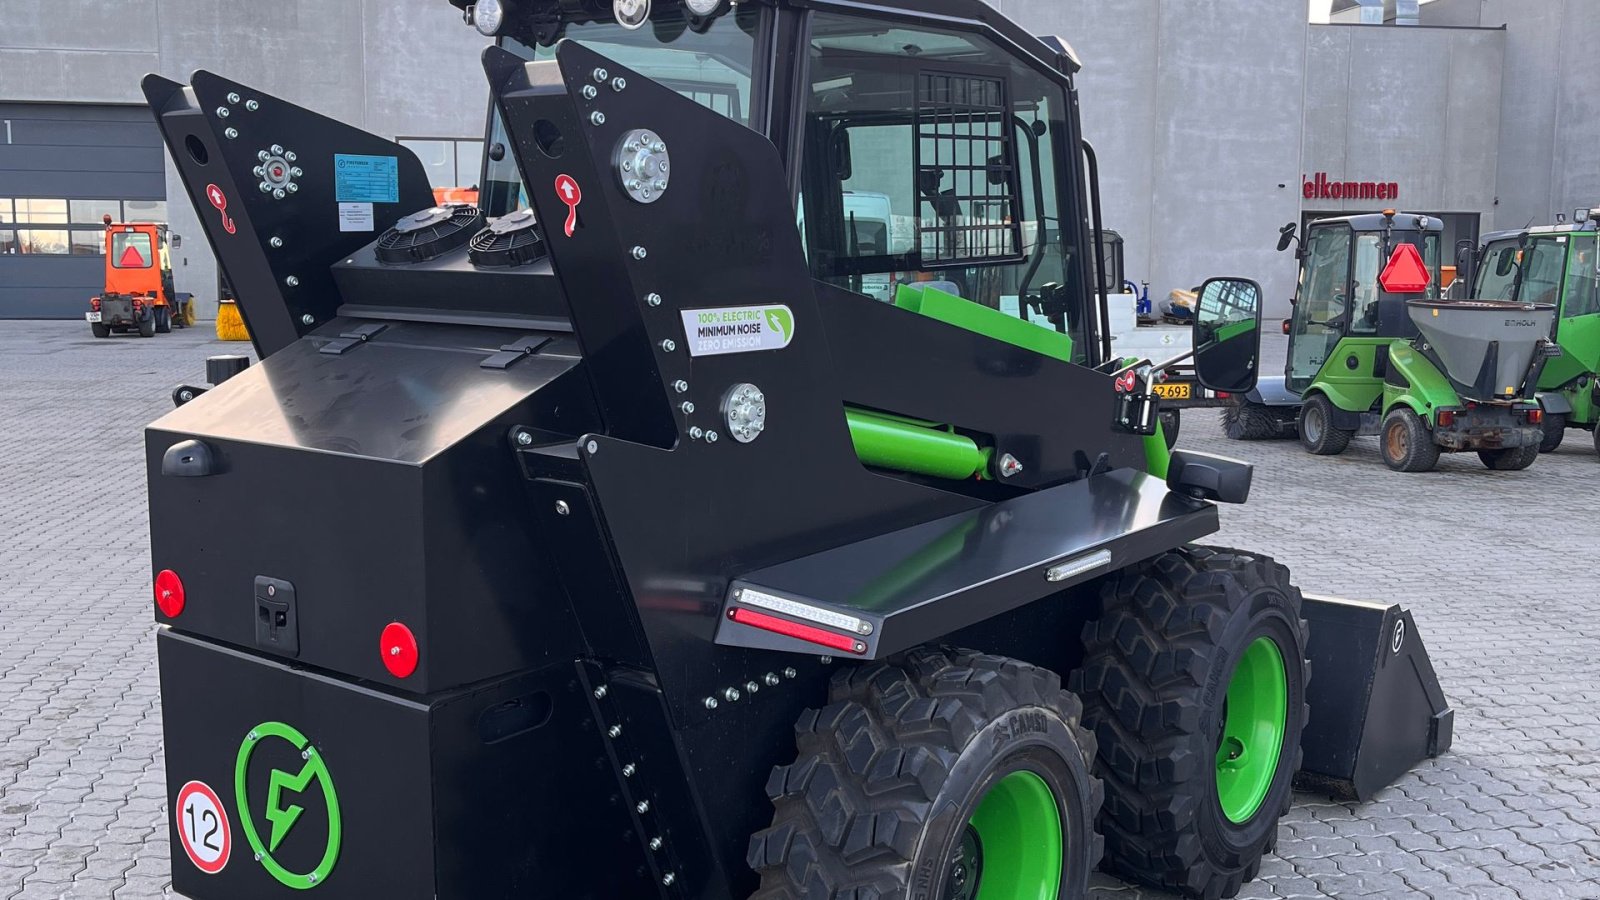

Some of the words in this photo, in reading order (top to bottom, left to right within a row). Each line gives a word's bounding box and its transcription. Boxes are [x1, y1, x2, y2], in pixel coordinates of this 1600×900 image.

[1303, 172, 1398, 199] elkommen
[698, 312, 719, 323] 100%
[723, 310, 760, 322] ELECTRIC
[698, 325, 735, 338] MINIMUM
[737, 323, 760, 335] NOISE
[698, 339, 719, 351] ZERO
[722, 336, 760, 350] EMISSION
[1168, 385, 1188, 397] 693
[186, 803, 220, 851] 12
